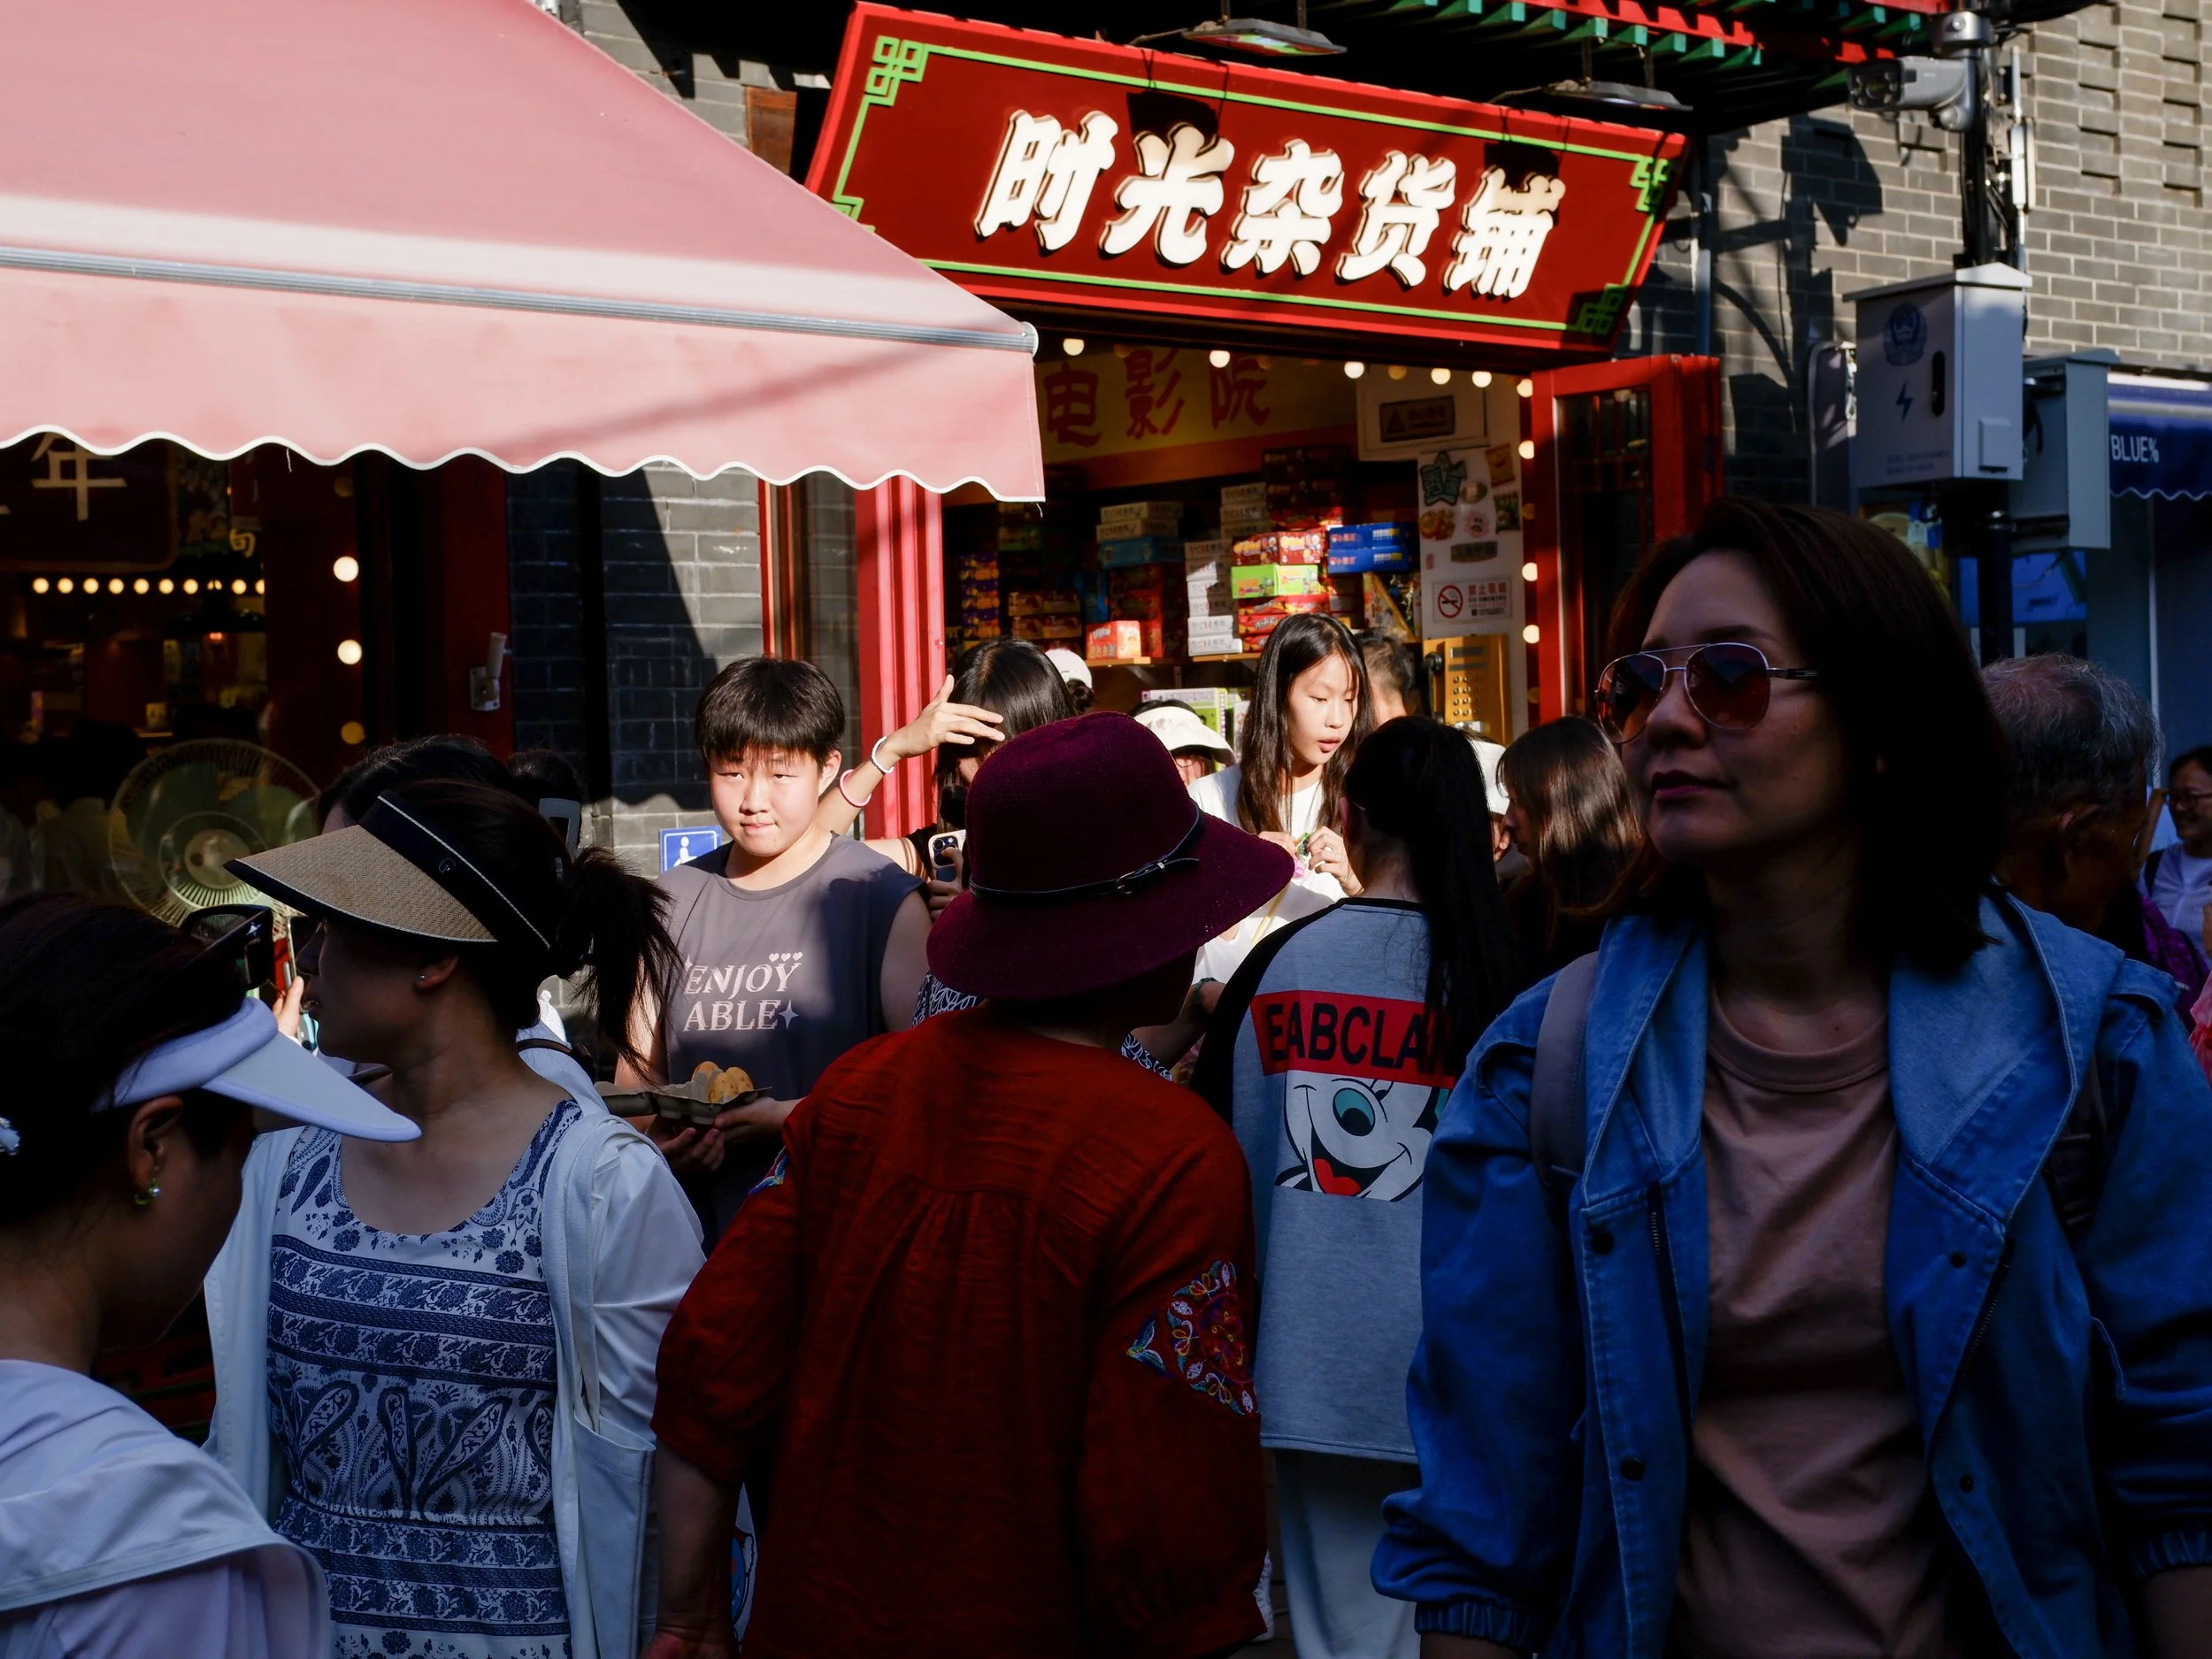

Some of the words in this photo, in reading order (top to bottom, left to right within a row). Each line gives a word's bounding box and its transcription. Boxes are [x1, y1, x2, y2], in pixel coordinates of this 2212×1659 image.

[974, 109, 1566, 300] 时光杂货铺
[1043, 347, 1271, 448] 电影院
[2110, 434, 2160, 464] BLUE%
[684, 962, 802, 1000] ENJOY
[683, 999, 780, 1033] ABLE
[1266, 1002, 1437, 1073] EABCLA
